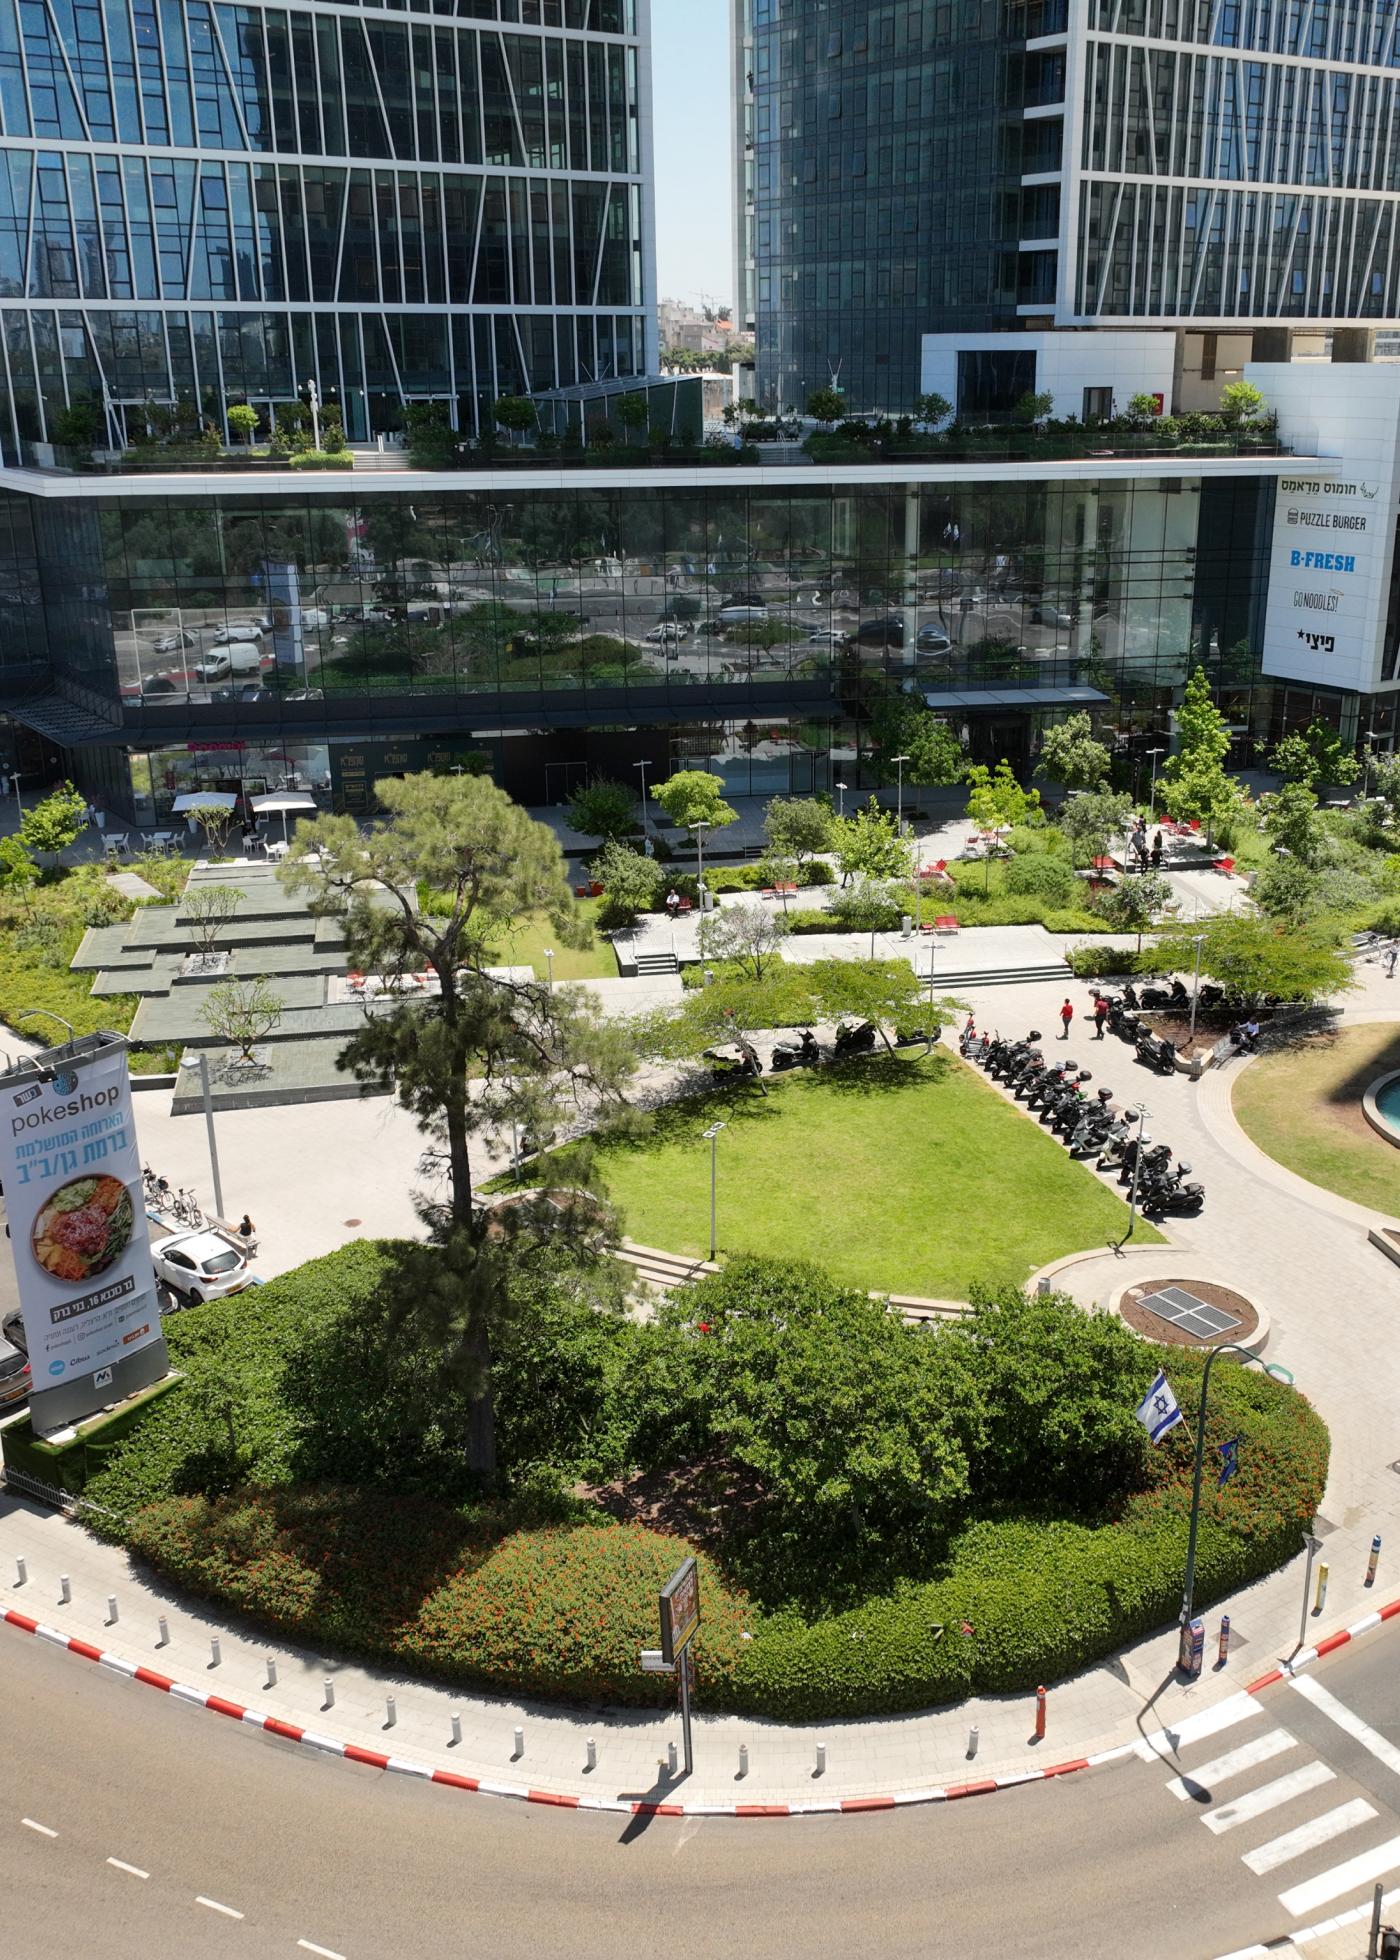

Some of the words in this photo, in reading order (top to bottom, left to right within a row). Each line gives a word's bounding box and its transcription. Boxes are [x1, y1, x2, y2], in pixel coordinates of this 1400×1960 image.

[1324, 482, 1356, 495] חומוס
[1300, 512, 1331, 528] PUZZLE
[1333, 515, 1366, 531] BURGER
[1290, 550, 1355, 572] B-FRESH
[11, 1086, 119, 1137] pokeshop
[81, 1111, 124, 1137] הארוחה
[15, 1130, 78, 1160] המושלמת
[83, 1130, 128, 1165] ברמת
